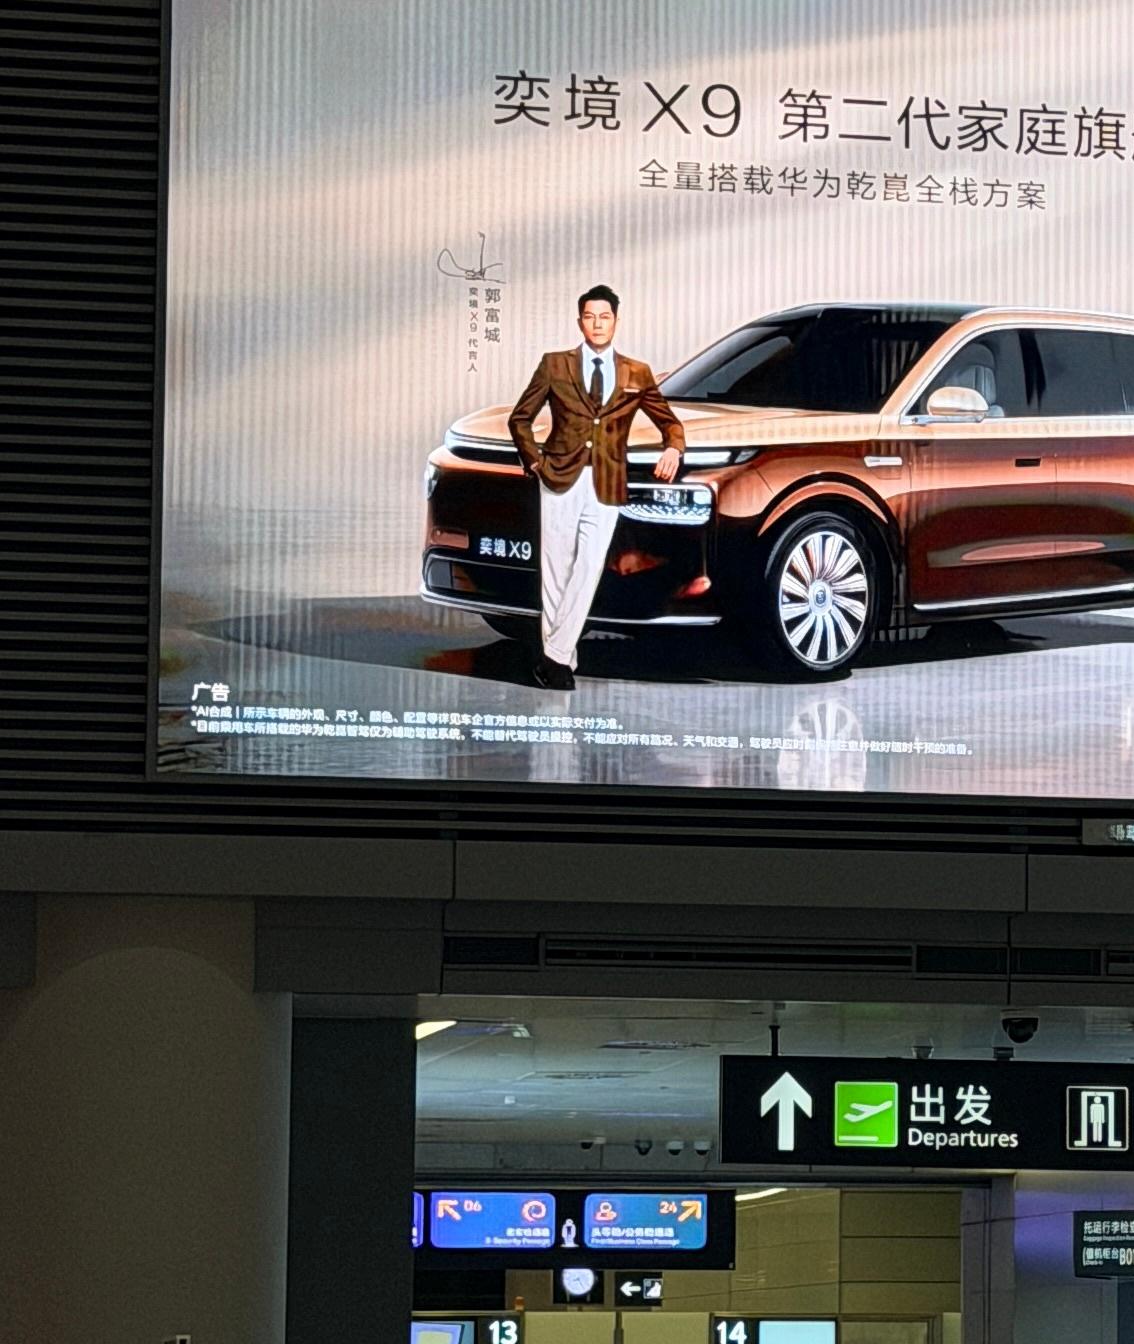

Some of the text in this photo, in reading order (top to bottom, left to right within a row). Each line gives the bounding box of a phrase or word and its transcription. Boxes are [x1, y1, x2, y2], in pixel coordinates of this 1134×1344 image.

[643, 82, 743, 138] X9
[638, 159, 1048, 211] 全量搭载华为乾崑全栈方案
[485, 287, 501, 343] 郭富城
[192, 680, 231, 703] 广告
[909, 1084, 993, 1126] 出发
[908, 1128, 1018, 1150] Departures
